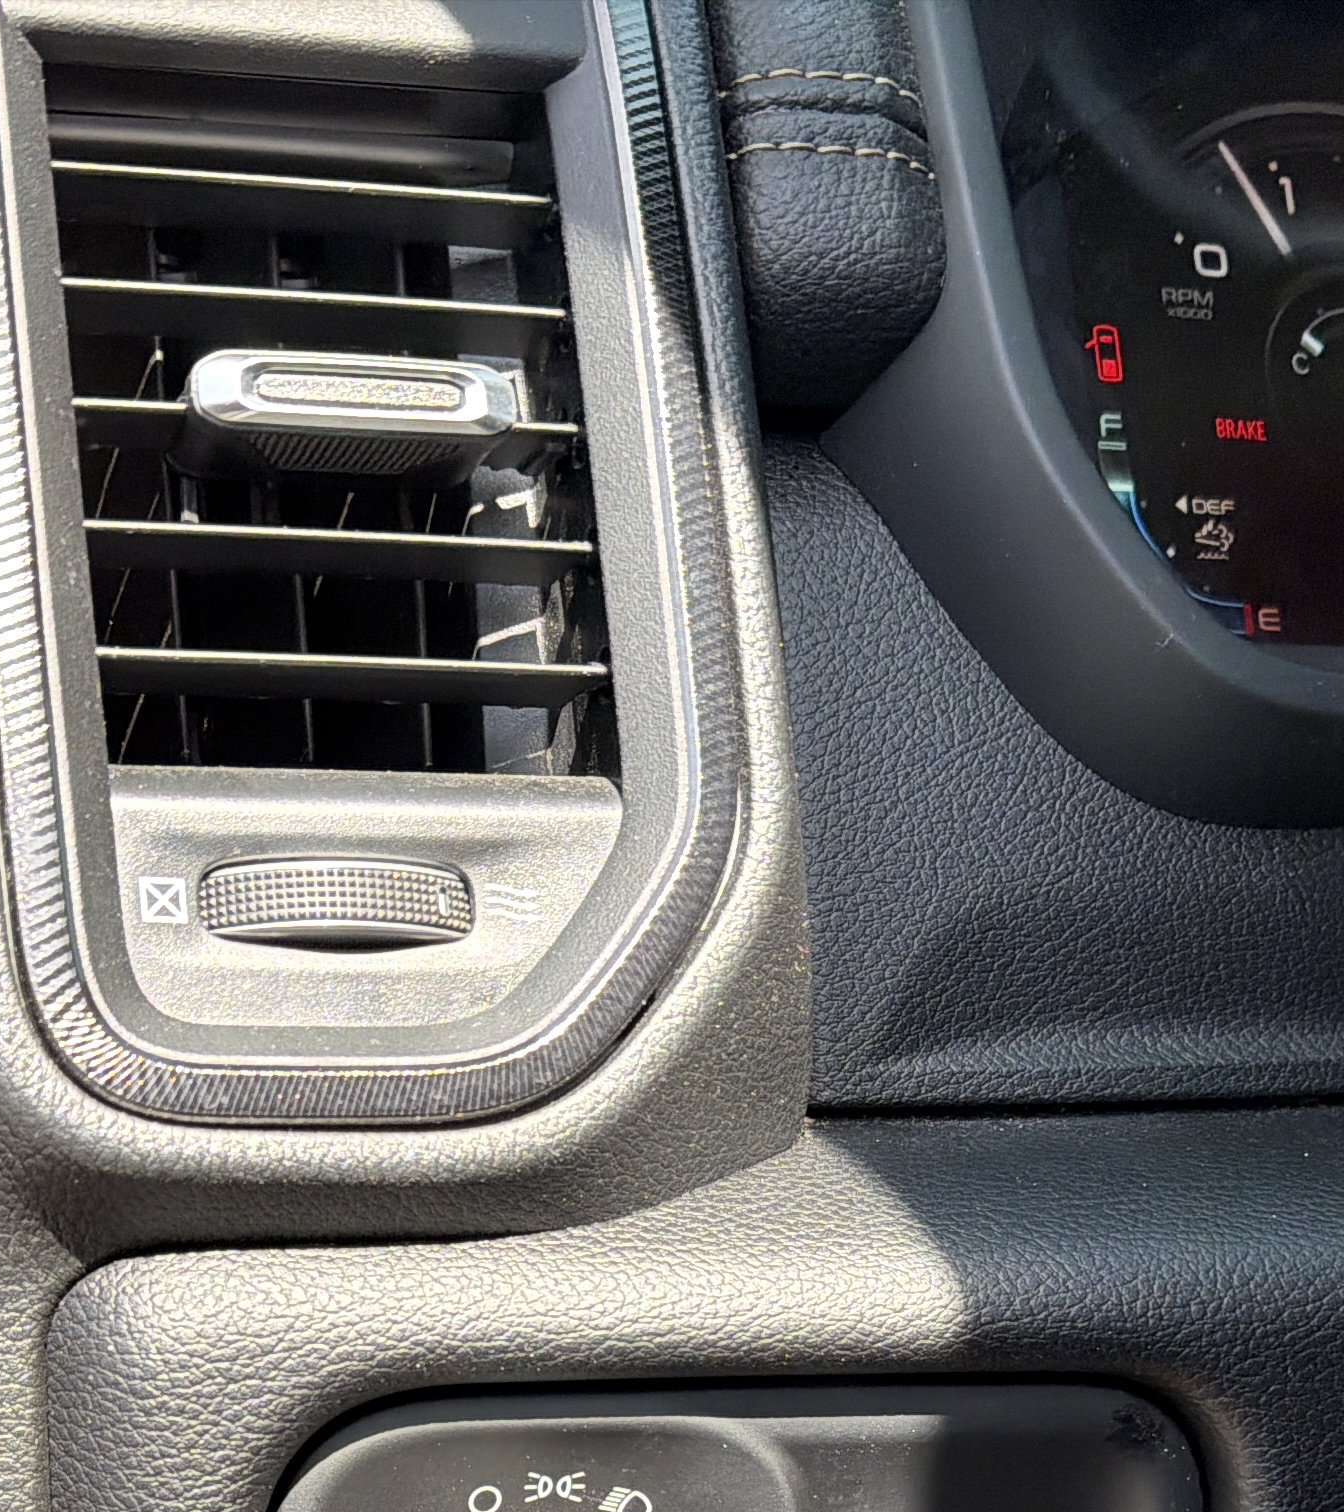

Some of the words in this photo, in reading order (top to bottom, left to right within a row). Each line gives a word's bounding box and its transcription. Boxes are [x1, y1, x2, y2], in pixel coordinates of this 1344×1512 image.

[1279, 176, 1296, 215] 1
[1193, 242, 1229, 278] 0
[1161, 287, 1214, 309] RPM
[1291, 354, 1310, 375] C
[1099, 412, 1123, 437] F
[1215, 417, 1267, 442] BRAKE
[1192, 498, 1235, 515] DEF
[1258, 608, 1281, 632] E
